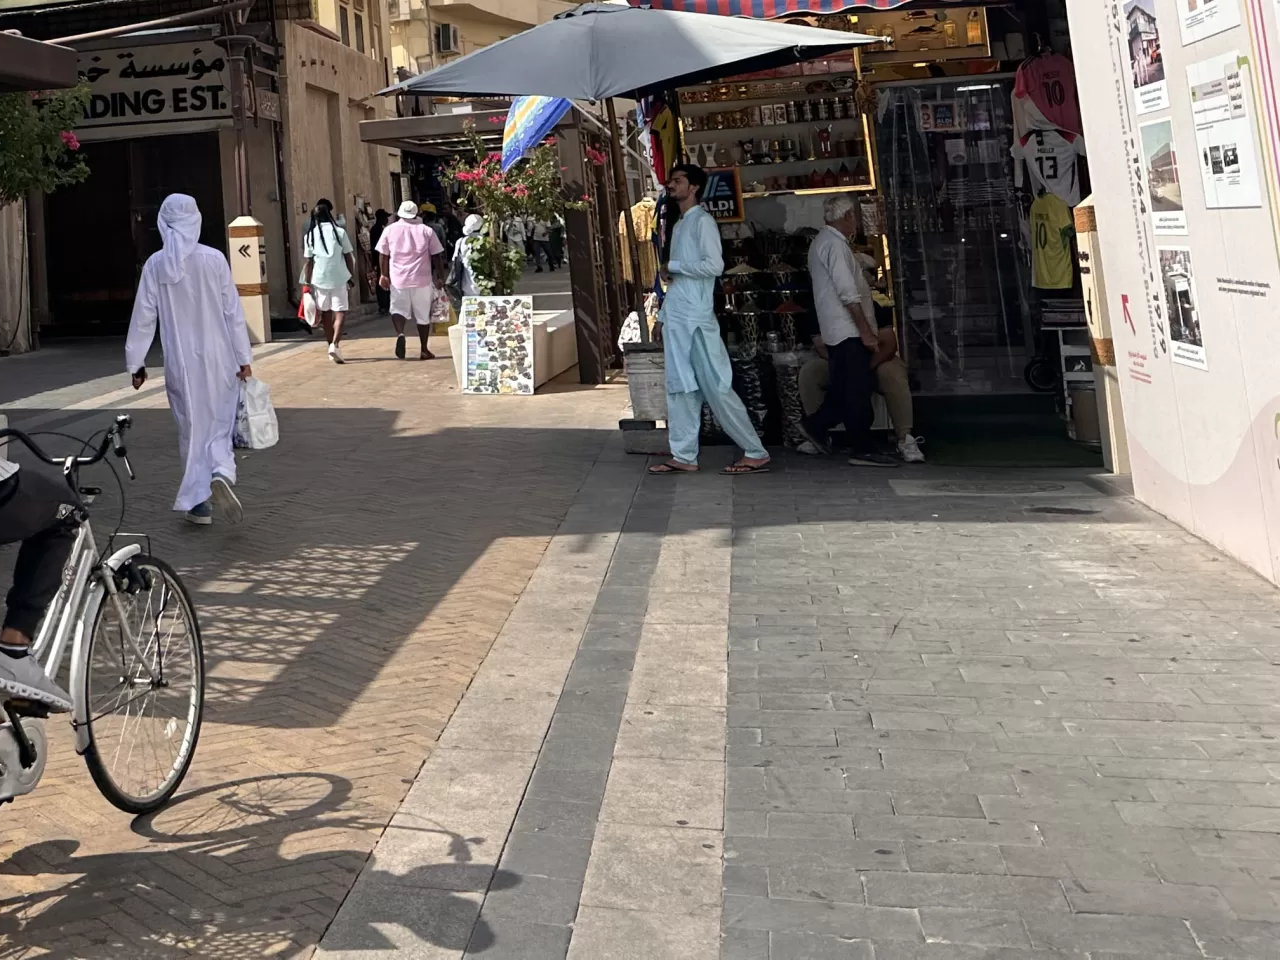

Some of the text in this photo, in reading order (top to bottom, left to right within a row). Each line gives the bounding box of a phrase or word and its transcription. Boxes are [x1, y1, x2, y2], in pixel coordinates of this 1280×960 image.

[117, 48, 225, 81] مؤسسة
[172, 85, 227, 113] EST.
[1043, 80, 1065, 108] 10
[1035, 156, 1058, 180] 13
[1133, 153, 1147, 216] 1964
[1035, 221, 1048, 249] 10
[1153, 291, 1167, 355] 1979
